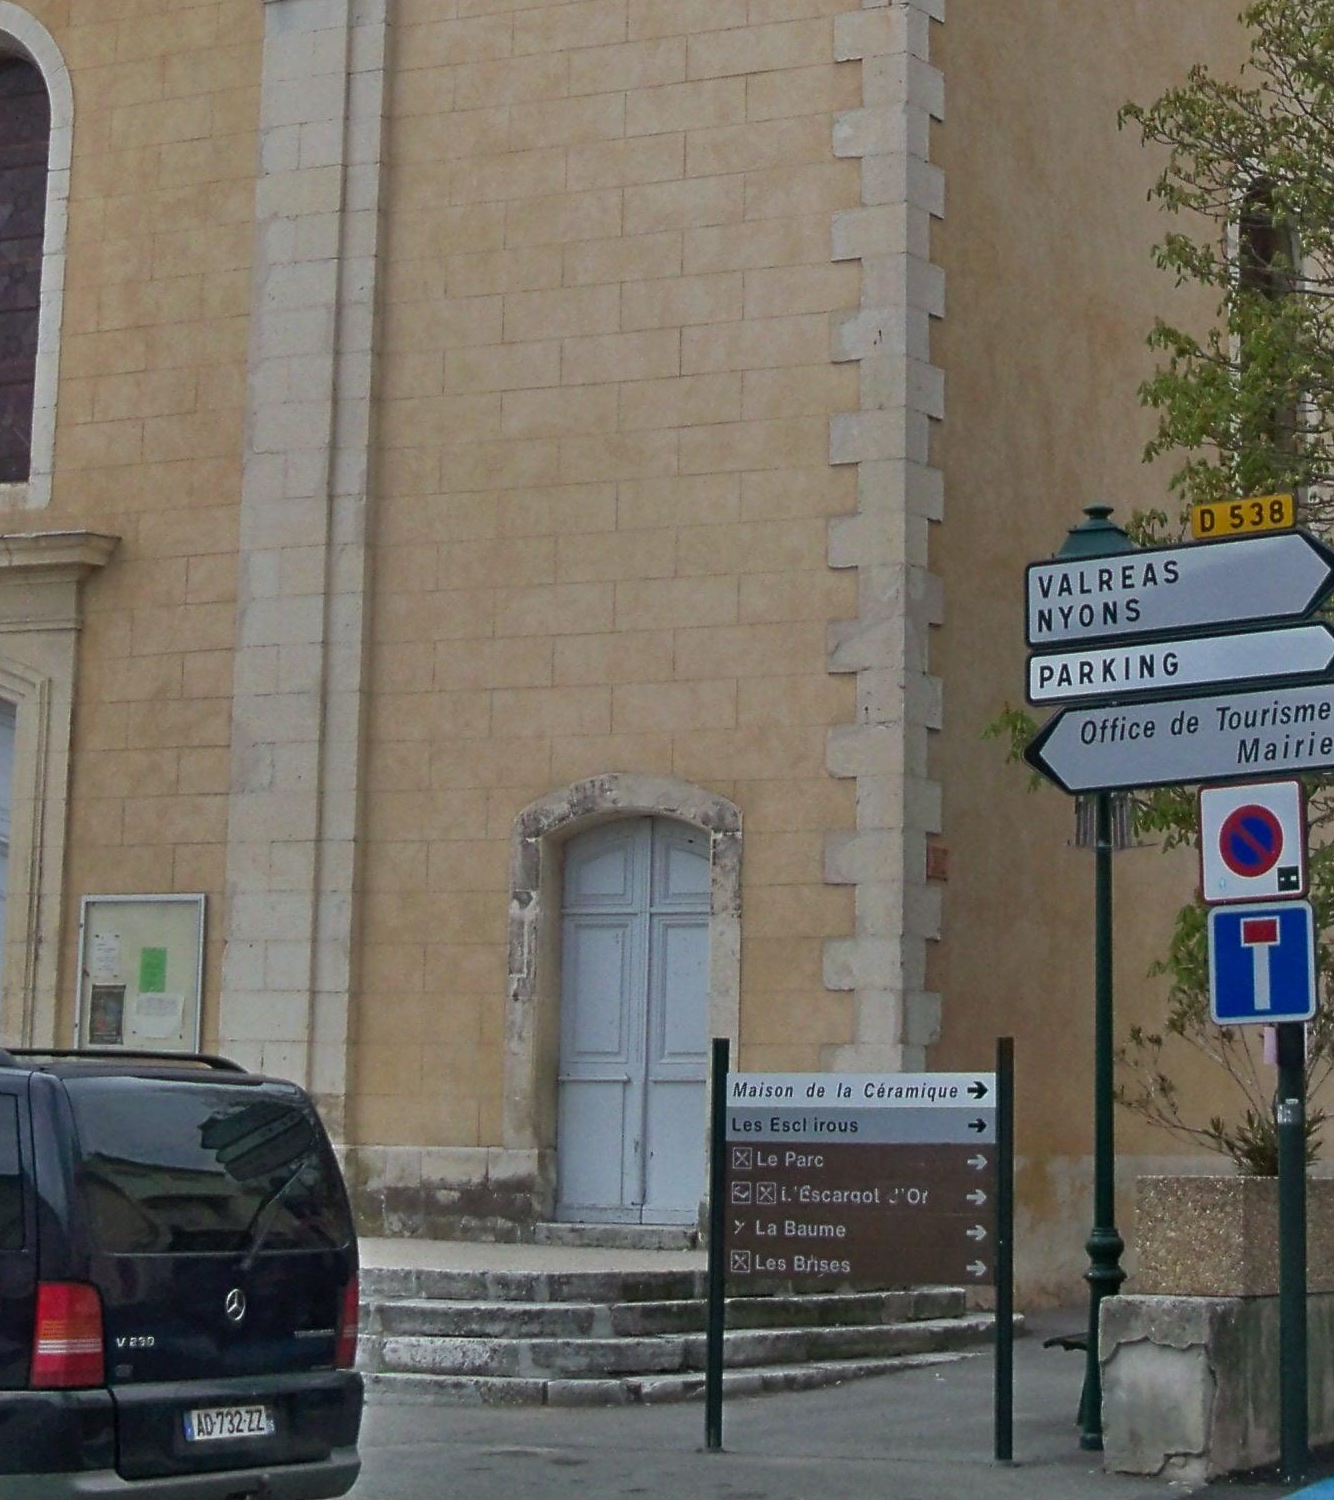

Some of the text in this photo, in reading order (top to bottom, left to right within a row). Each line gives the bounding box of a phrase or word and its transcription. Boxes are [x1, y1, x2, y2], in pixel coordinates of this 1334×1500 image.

[1199, 499, 1285, 533] D 538
[1037, 559, 1180, 599] VALREAS
[1037, 597, 1141, 633] NYONS
[1039, 651, 1180, 689] PARKING
[1080, 700, 1332, 745] Office de Tourisme
[1236, 731, 1334, 764] Mairie
[732, 1081, 959, 1102] Maison de la Céramique
[731, 1117, 762, 1133] Les
[756, 1150, 825, 1168] Le Parc
[755, 1219, 847, 1238] La Baume
[755, 1254, 852, 1274] Les Brises
